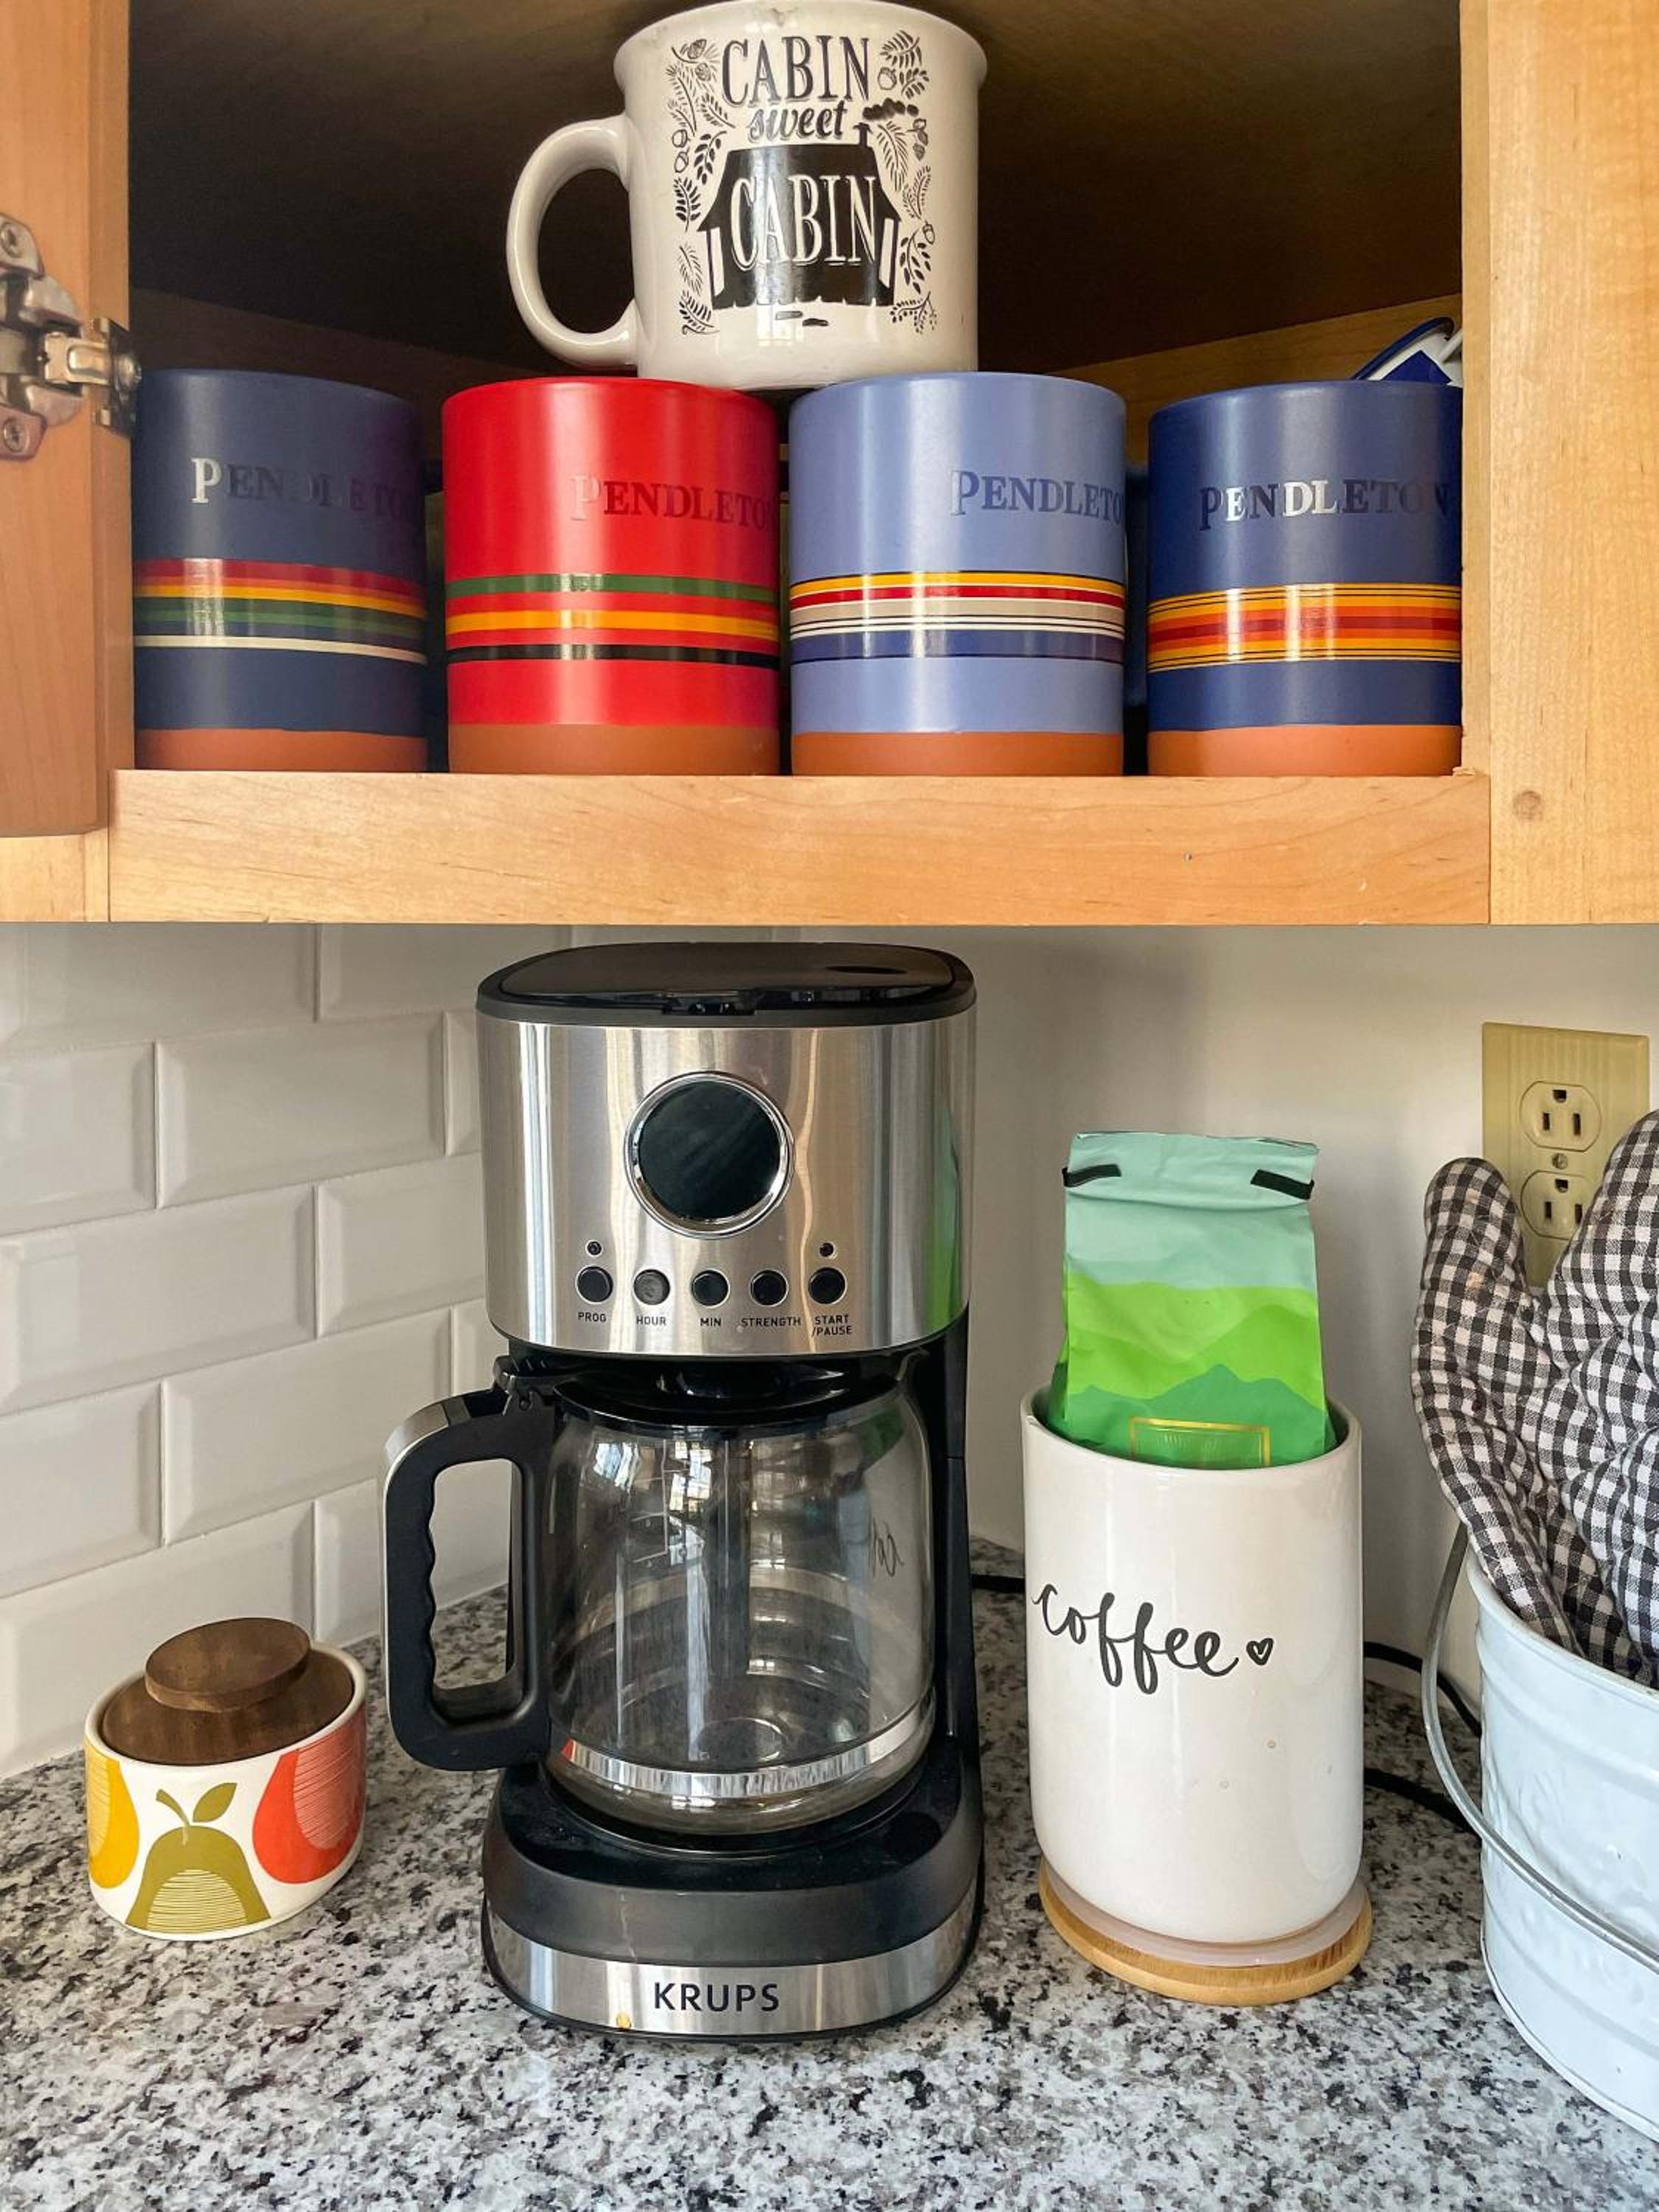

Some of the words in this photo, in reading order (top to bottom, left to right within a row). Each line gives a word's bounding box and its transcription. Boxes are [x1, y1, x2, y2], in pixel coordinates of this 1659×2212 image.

[721, 35, 870, 108] CABIN
[746, 100, 848, 143] sweet
[730, 174, 877, 272] CABIN
[577, 1312, 608, 1323] PROG
[636, 1316, 667, 1326] HOUR
[700, 1318, 722, 1327] MIN
[741, 1317, 801, 1327] STRENGTH
[815, 1314, 849, 1325] START
[811, 1326, 852, 1337] /PAUSE
[1032, 1584, 1239, 1694] coffee
[654, 1982, 779, 2012] KRUPS
